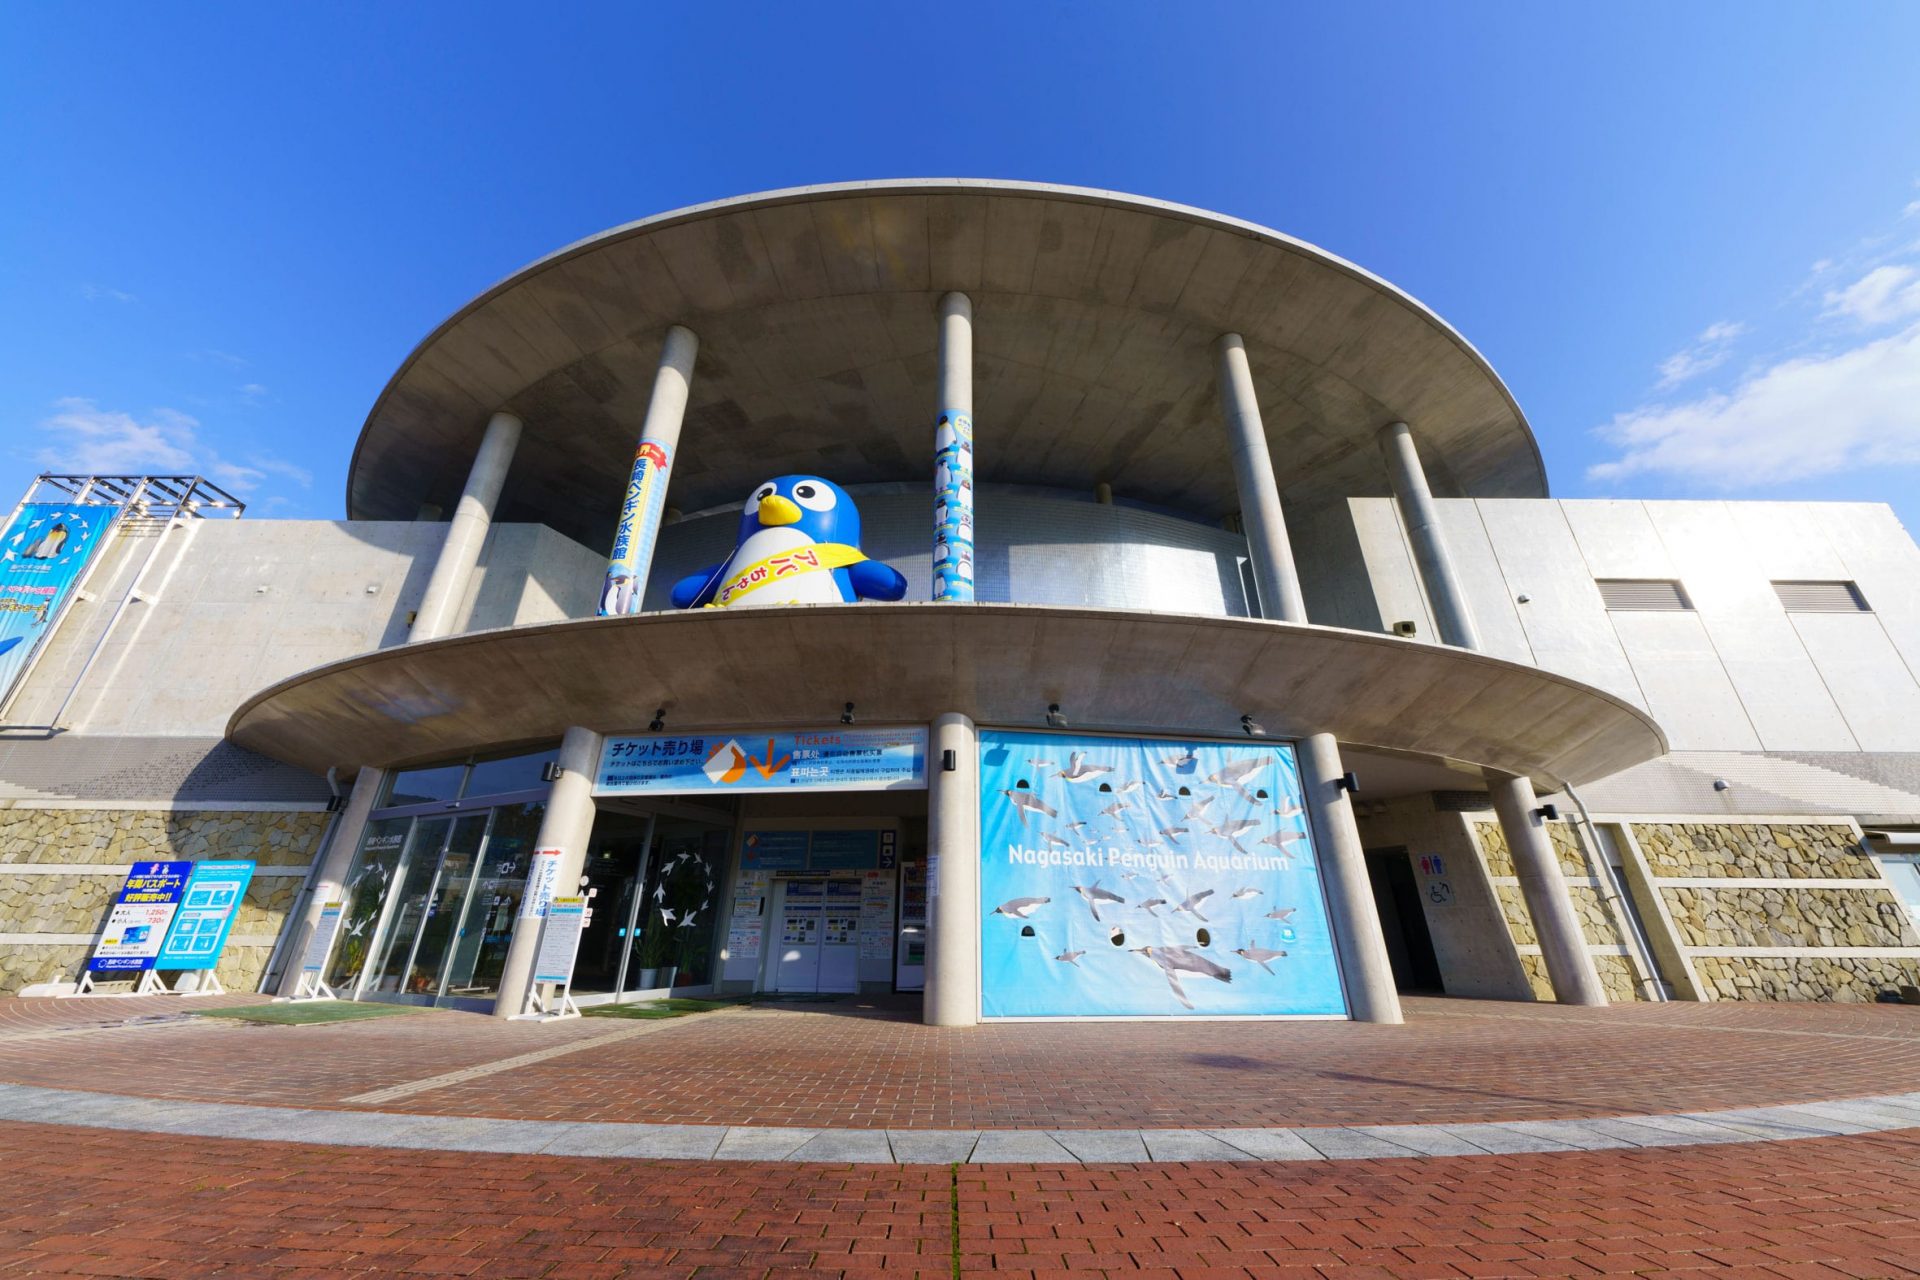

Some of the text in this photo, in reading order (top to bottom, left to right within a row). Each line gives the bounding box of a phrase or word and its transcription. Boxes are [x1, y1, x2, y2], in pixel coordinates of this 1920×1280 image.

[611, 458, 647, 561] 長崎ペンギン水族館
[722, 550, 818, 601] アバちゃん
[612, 739, 704, 757] チケット売り場
[795, 735, 841, 745] Tickets
[1008, 843, 1289, 873] Nagasaki Penguin Aquarium
[535, 860, 558, 917] チケット売り場
